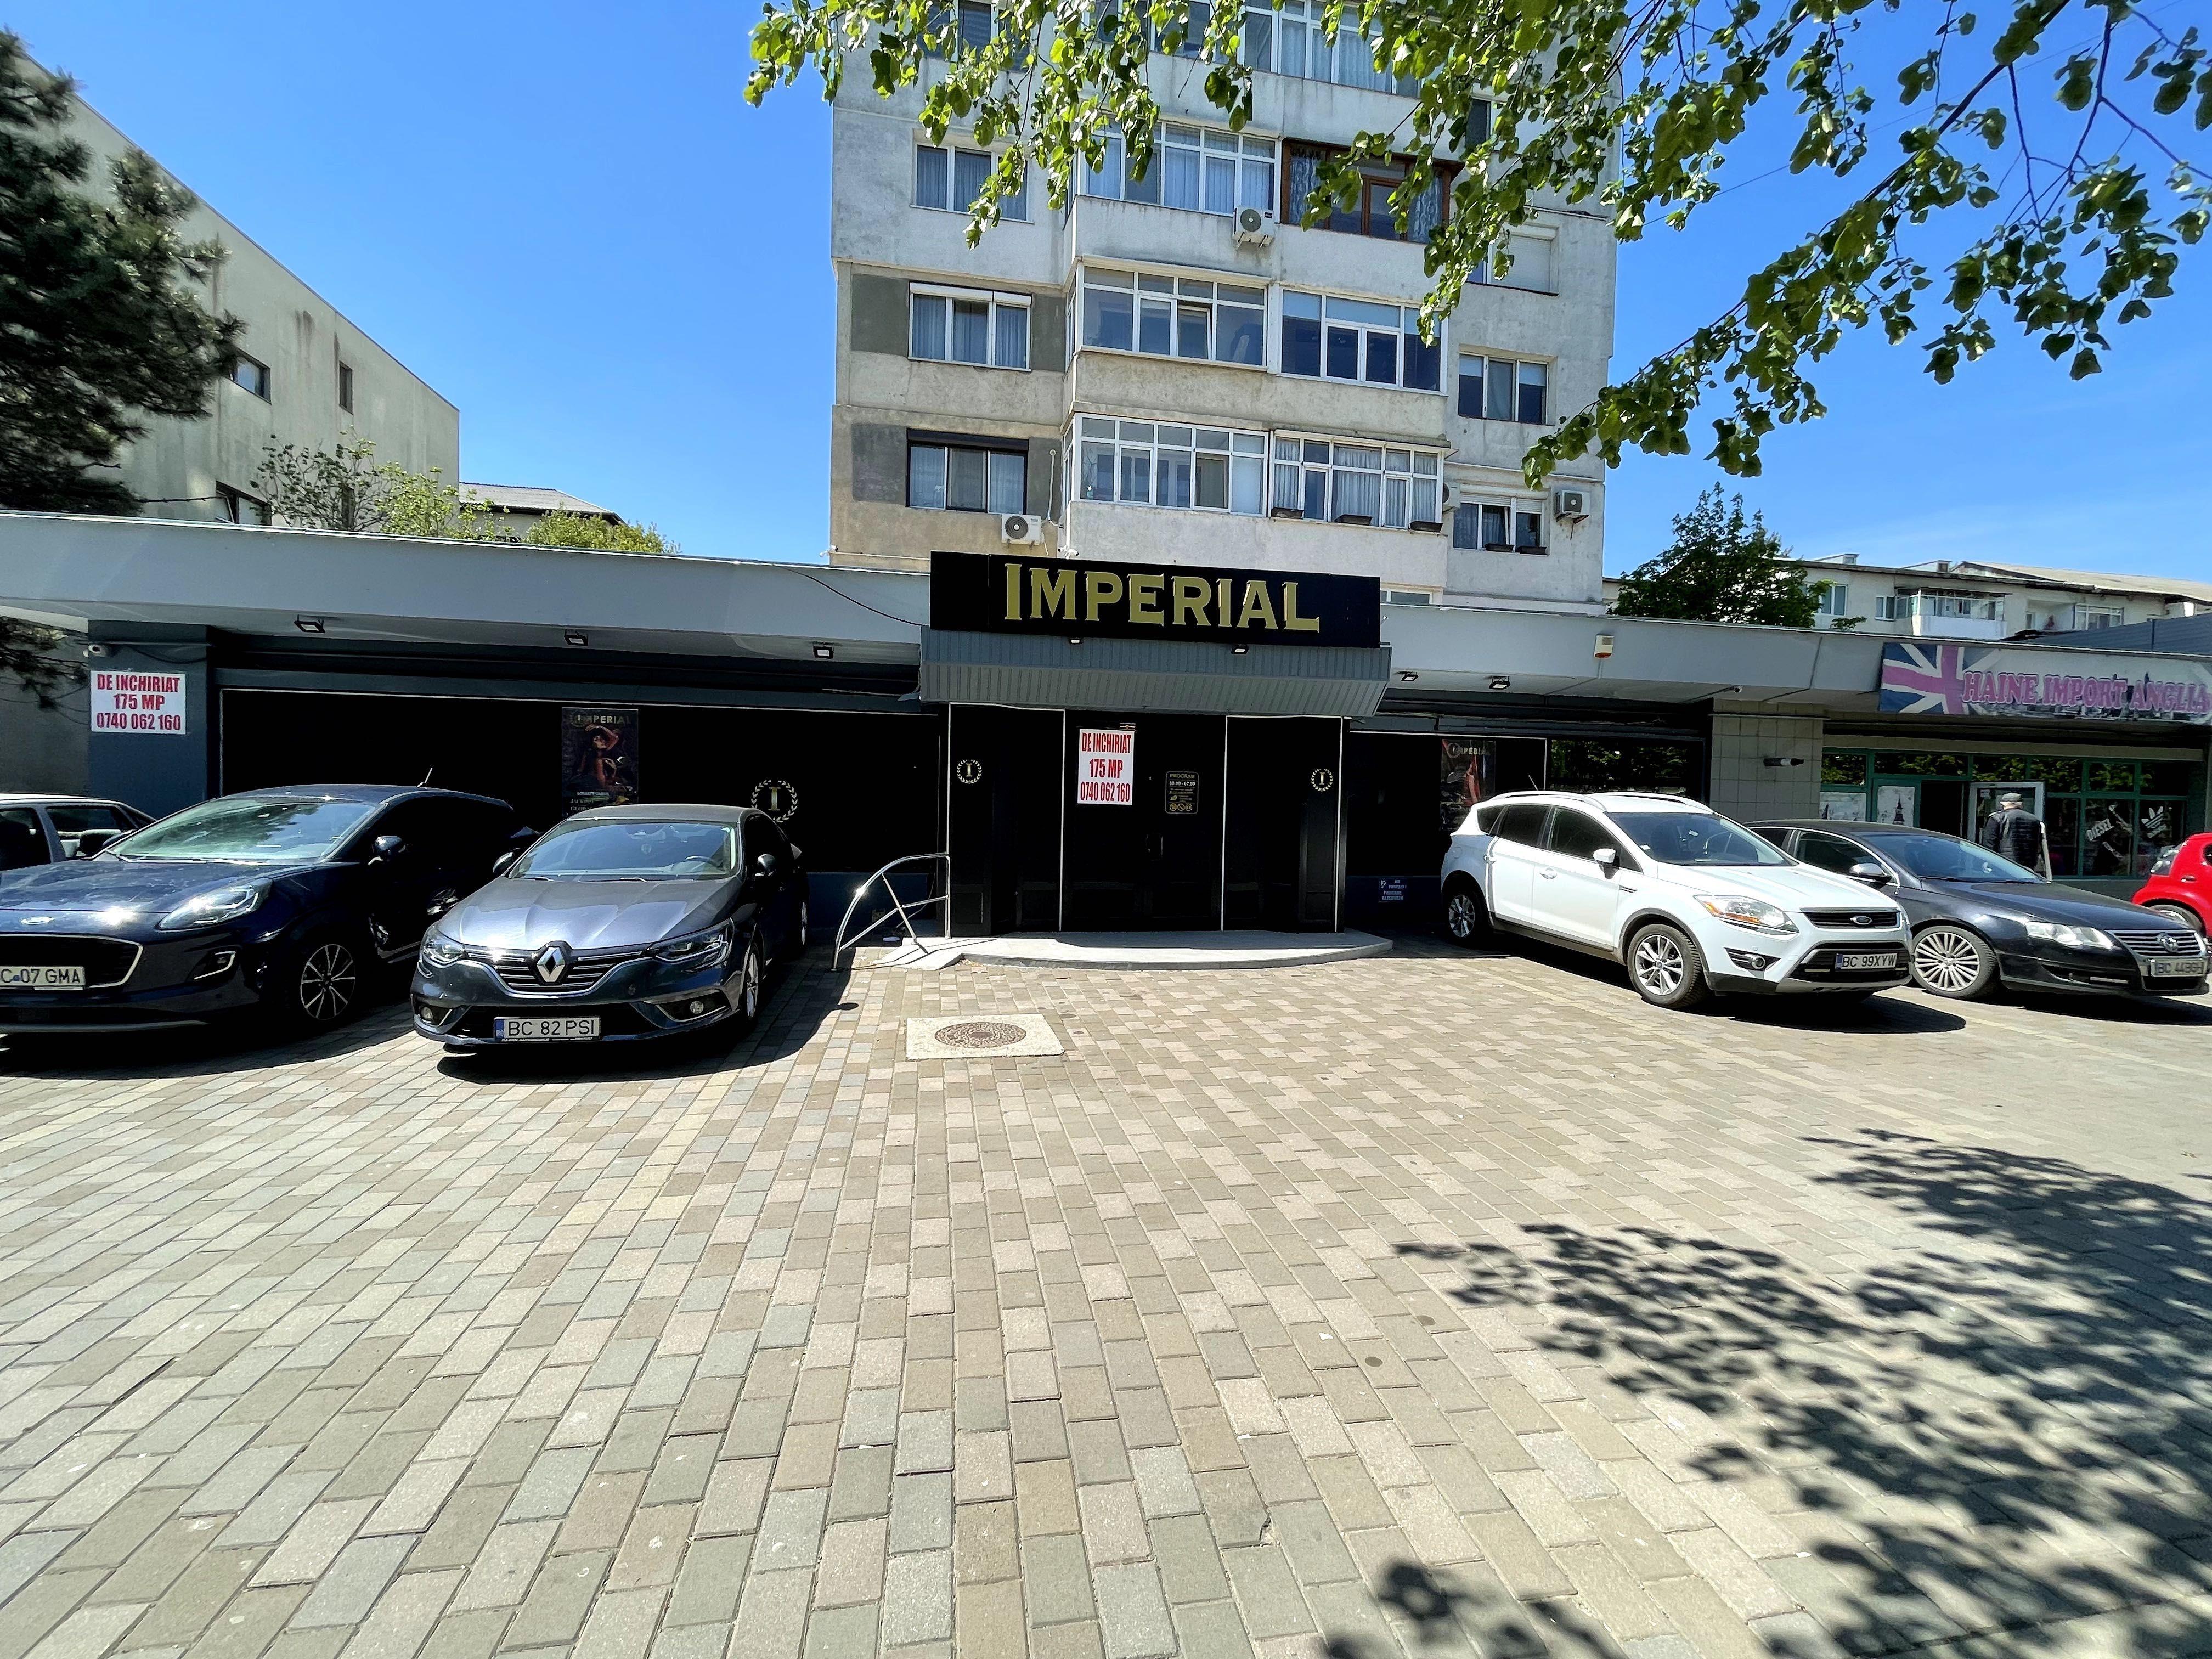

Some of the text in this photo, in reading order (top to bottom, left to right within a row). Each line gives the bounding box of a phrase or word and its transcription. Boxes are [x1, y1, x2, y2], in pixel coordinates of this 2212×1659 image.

[1005, 563, 1319, 633] IMPERIAL
[97, 674, 180, 692] DE INCHIRIAT
[1962, 671, 2211, 714] HAINE IMPORT ANGLIA
[113, 693, 165, 710] 175 MP
[97, 712, 180, 731] 0740 062 160
[1082, 732, 1131, 753] DE INCHIRIAT
[1089, 759, 1123, 778] 175 MP
[1080, 781, 1130, 802] 0740 062 160
[1842, 956, 1858, 967] BC
[20, 968, 40, 984] 07
[45, 969, 81, 984] GMA
[509, 1021, 533, 1036] BC
[540, 1020, 561, 1036] 82
[566, 1019, 594, 1035] PSI
